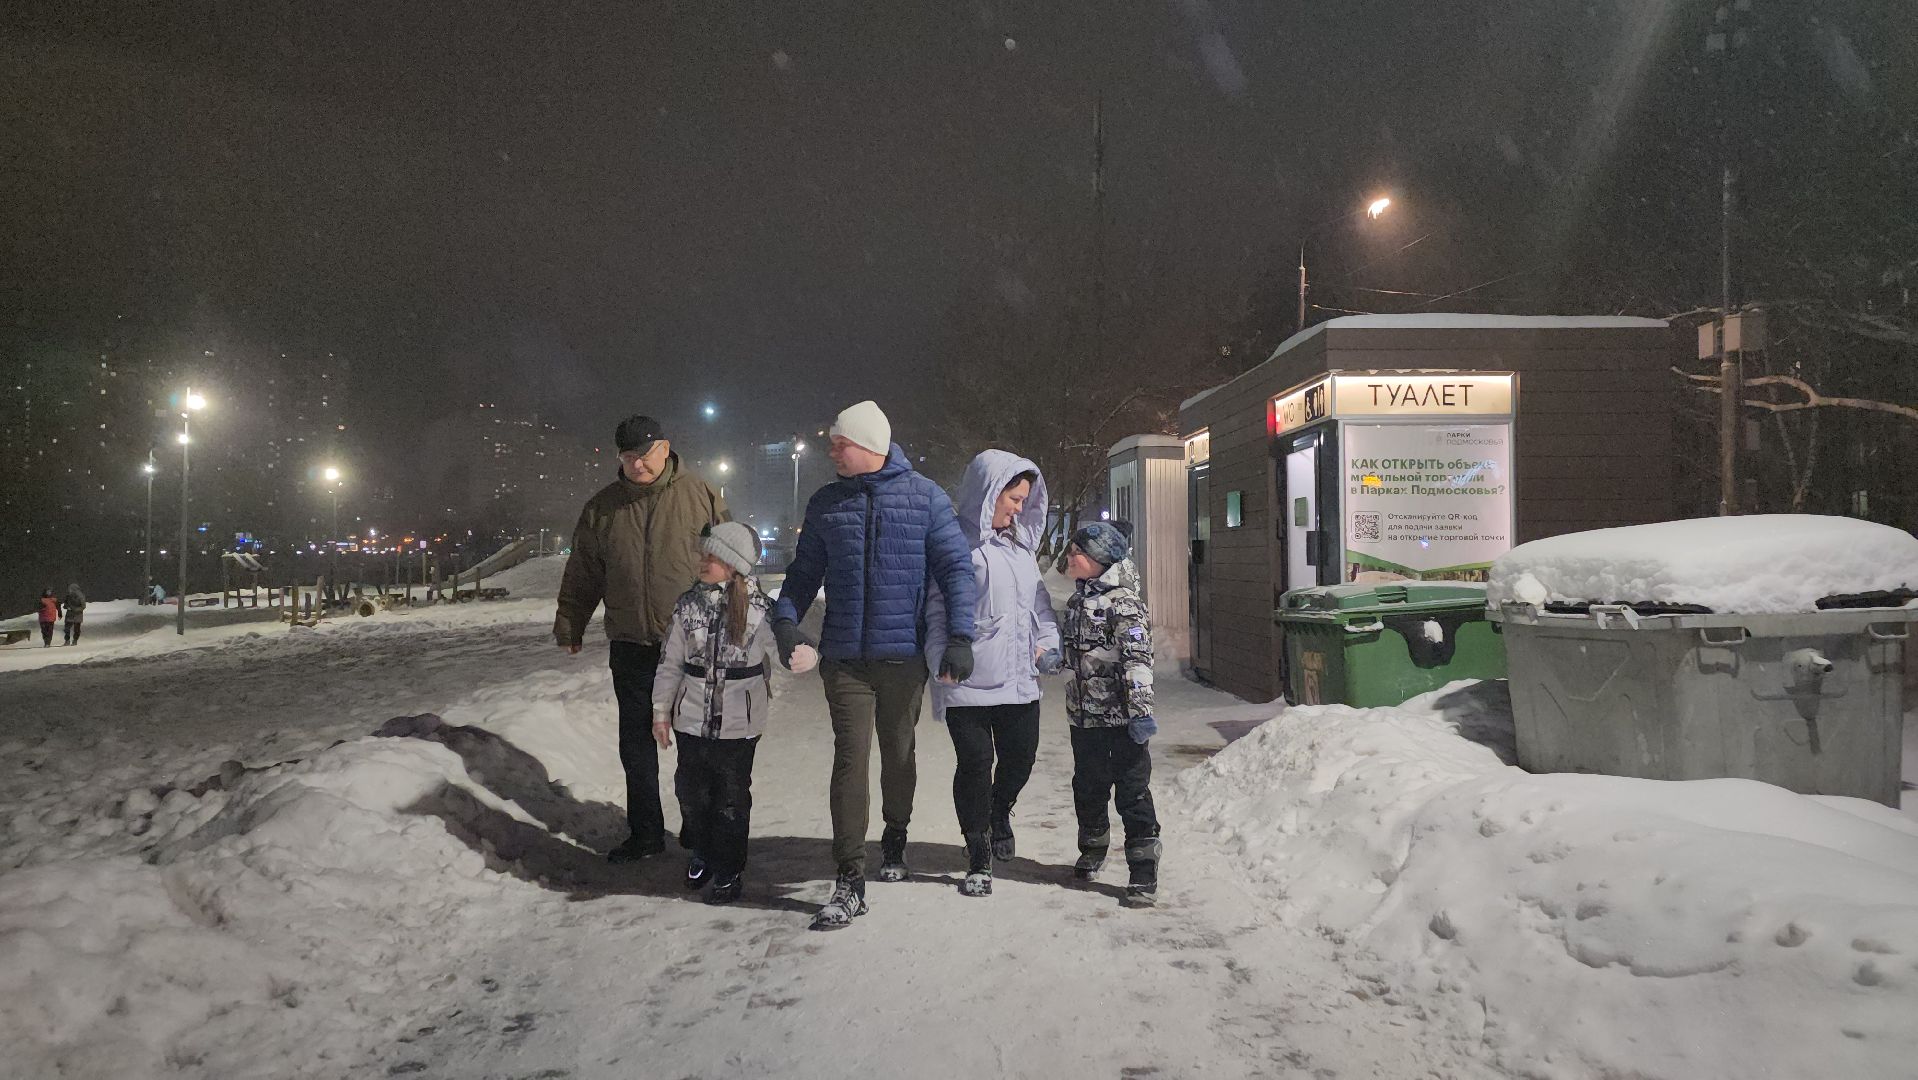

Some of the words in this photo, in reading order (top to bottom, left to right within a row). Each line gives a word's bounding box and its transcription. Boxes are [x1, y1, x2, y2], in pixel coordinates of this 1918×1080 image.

[1368, 384, 1474, 406] ТУАЛЕТ
[1351, 458, 1379, 470] КАК
[1381, 458, 1445, 470] ОТКРЫТЬ
[1351, 487, 1357, 495] в
[1360, 485, 1407, 496] Парках
[1411, 485, 1505, 496] Подмосковья?
[1388, 513, 1446, 521] Отсканируйте
[1440, 533, 1479, 541] торговой
